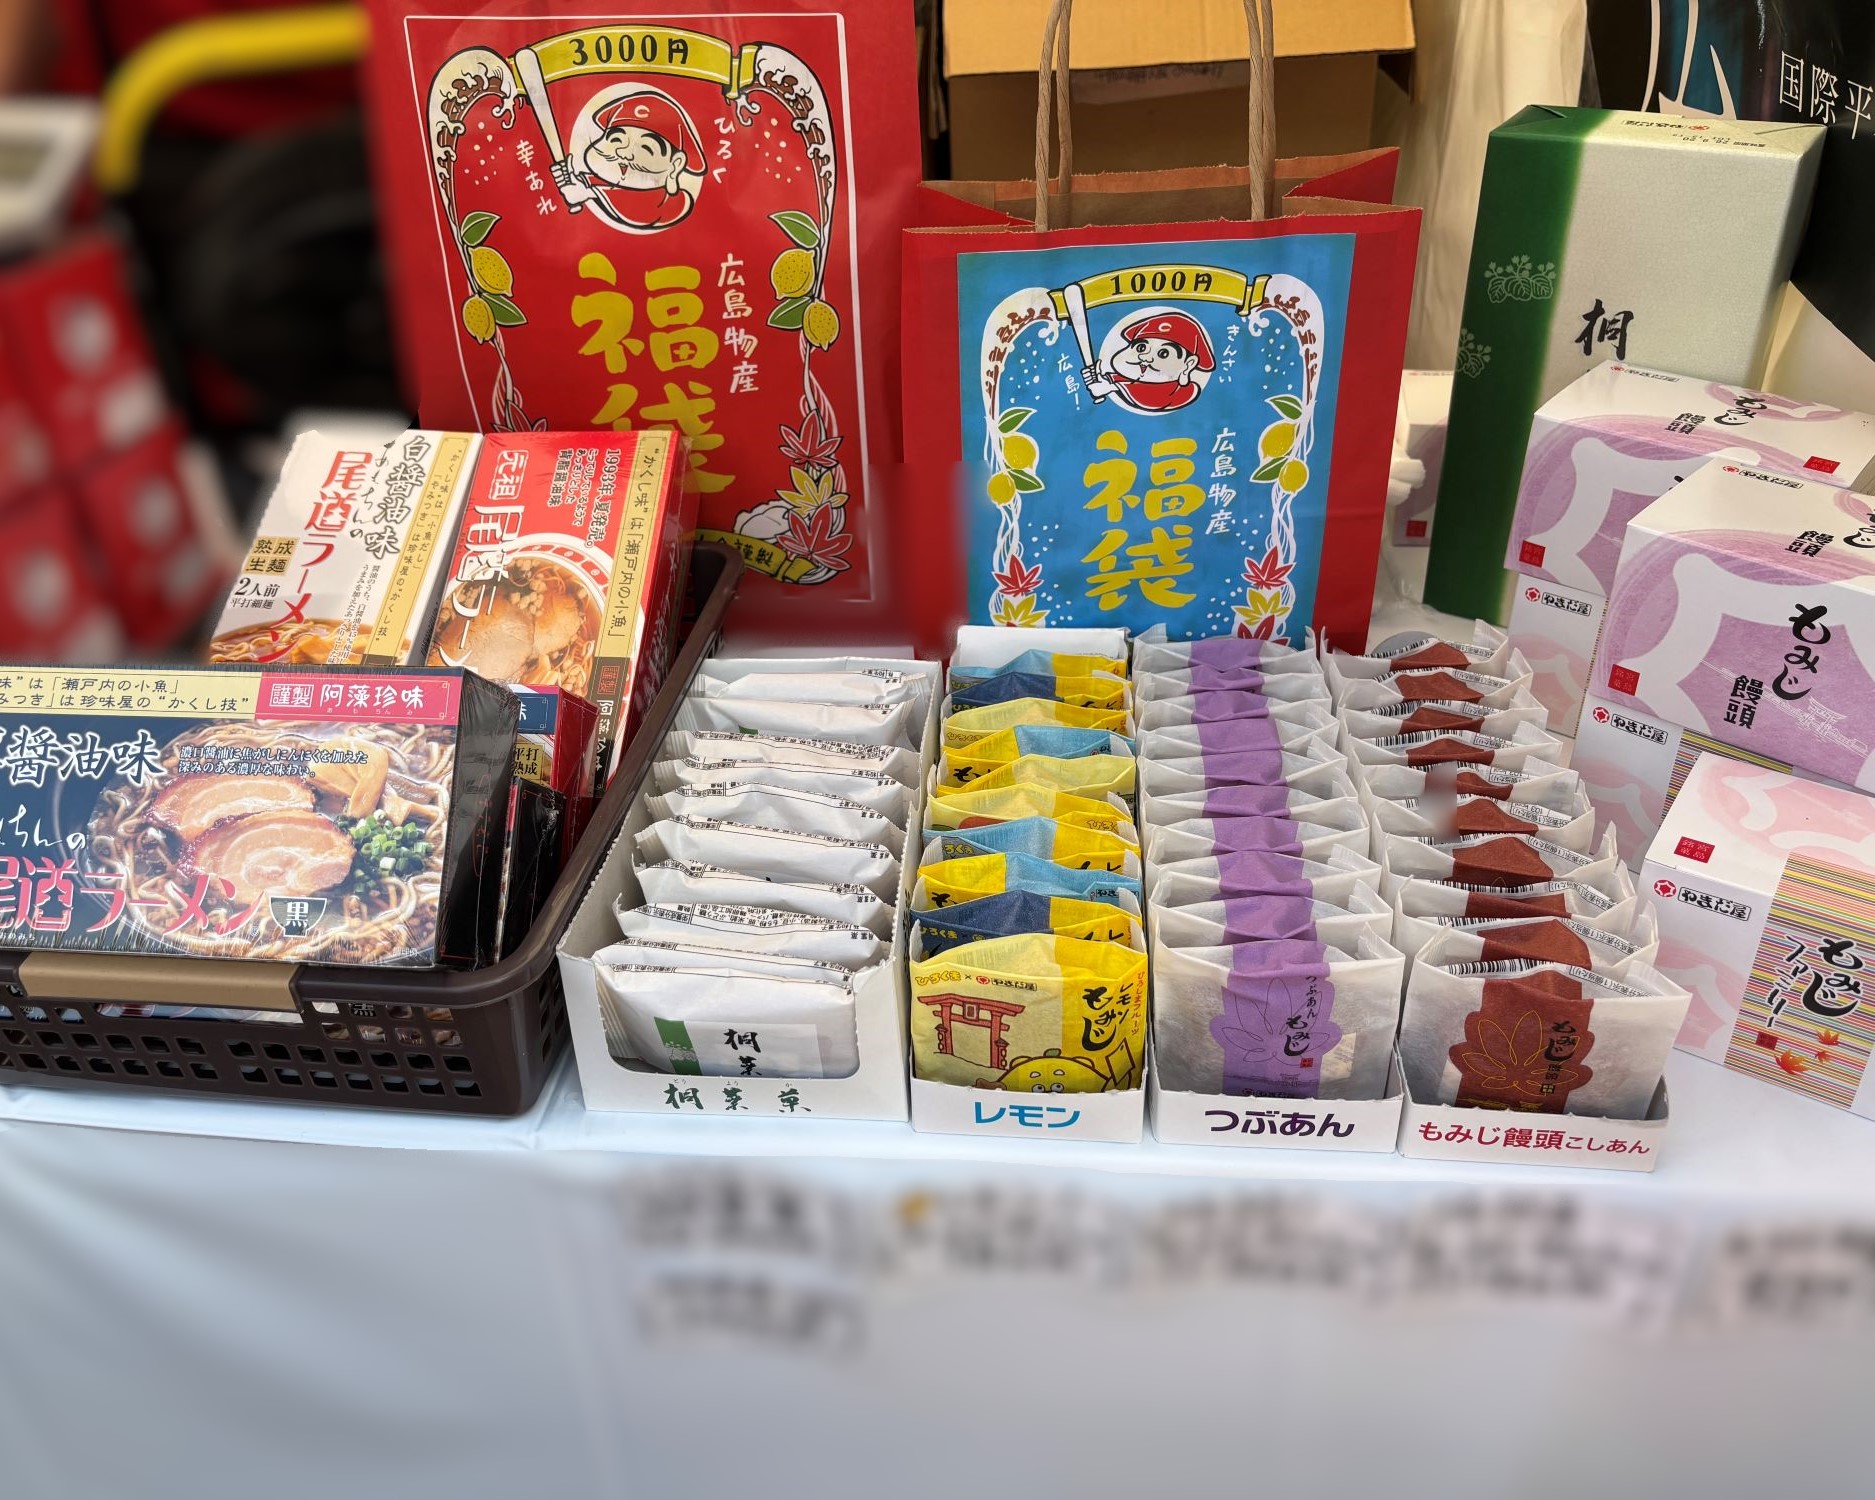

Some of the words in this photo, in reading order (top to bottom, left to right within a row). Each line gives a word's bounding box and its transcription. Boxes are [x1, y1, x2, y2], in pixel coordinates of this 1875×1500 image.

[572, 33, 688, 66] 3000円
[1778, 51, 1875, 140] 国際平
[713, 116, 736, 184] ひろく
[516, 139, 557, 215] 幸あれ
[1111, 272, 1213, 296] 1000円
[716, 252, 759, 394] 広島物産
[1575, 299, 1635, 361] 桐
[572, 252, 737, 493] 福袋
[1219, 324, 1241, 384] きんさい
[1057, 353, 1081, 411] 広島!
[1664, 412, 1707, 435] 饅頭
[1713, 395, 1767, 426] もみじ
[492, 450, 527, 499] 元祖
[1205, 428, 1237, 536] 広島物産
[365, 435, 431, 559] 白醤油味
[1082, 430, 1206, 611] 福袋
[255, 539, 296, 556] 熟成
[258, 450, 373, 663] 尾道ラーメン
[1785, 530, 1835, 557] 饅頭
[234, 578, 280, 597] 2人前
[1542, 592, 1592, 617] やまだ屋
[1772, 603, 1832, 700] もみじ
[271, 684, 312, 707] 謹製
[320, 684, 424, 709] 阿藻珍味
[1723, 674, 1764, 730] 饅頭
[1612, 714, 1668, 745] やまだ屋
[0, 725, 167, 787] 醤油味
[178, 760, 316, 777] 深みのある濃厚な味わい。
[0, 804, 87, 849] ちんの
[285, 901, 310, 927] 黒
[1680, 888, 1750, 920] やまだ屋
[915, 970, 962, 987] ひろくま
[1305, 975, 1318, 1019] つぶあん
[1765, 934, 1810, 1028] ファミリー
[1802, 937, 1864, 1017] もみじ
[1081, 986, 1117, 1052] もみじ
[1116, 982, 1134, 1025] レモン
[1130, 970, 1147, 1037] ひろしまフルーツ
[1283, 1014, 1310, 1057] もみじ
[1544, 1020, 1577, 1061] もみじ
[974, 1101, 1081, 1129] レモン
[1204, 1109, 1355, 1138] つぶあん
[1418, 1121, 1650, 1156] もみじ饅頭こしあん
